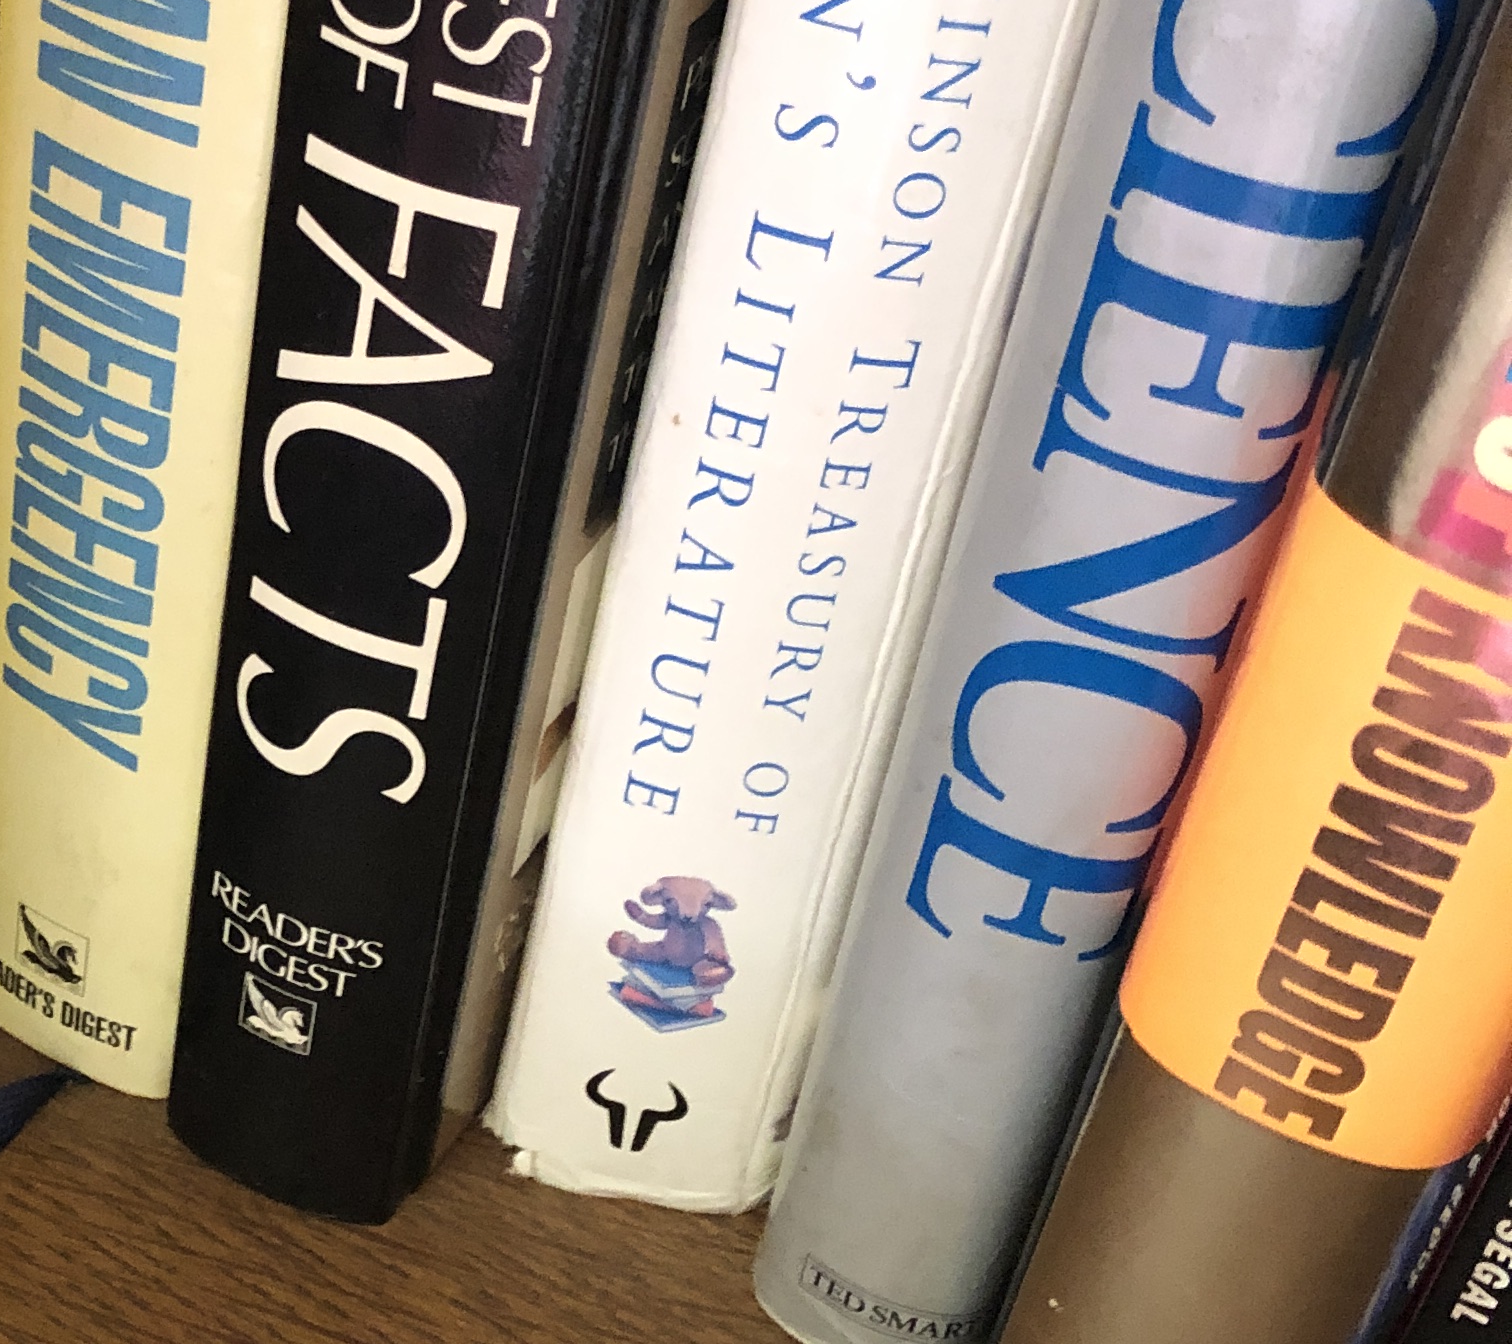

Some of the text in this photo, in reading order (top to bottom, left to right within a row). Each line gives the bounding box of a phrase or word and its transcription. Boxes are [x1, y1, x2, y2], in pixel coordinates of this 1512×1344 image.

[3, 130, 191, 772] EMERGENCY
[237, 134, 521, 805] FACTS
[622, 209, 834, 817] LITERATURE
[763, 340, 922, 722] TREASURY
[733, 761, 790, 836] OF
[1213, 587, 1512, 1143] KNOWLEDGE
[60, 1001, 138, 1052] DIGEST
[211, 871, 384, 969] READER'S
[222, 917, 357, 997] DIGEST
[810, 1265, 865, 1313] TED
